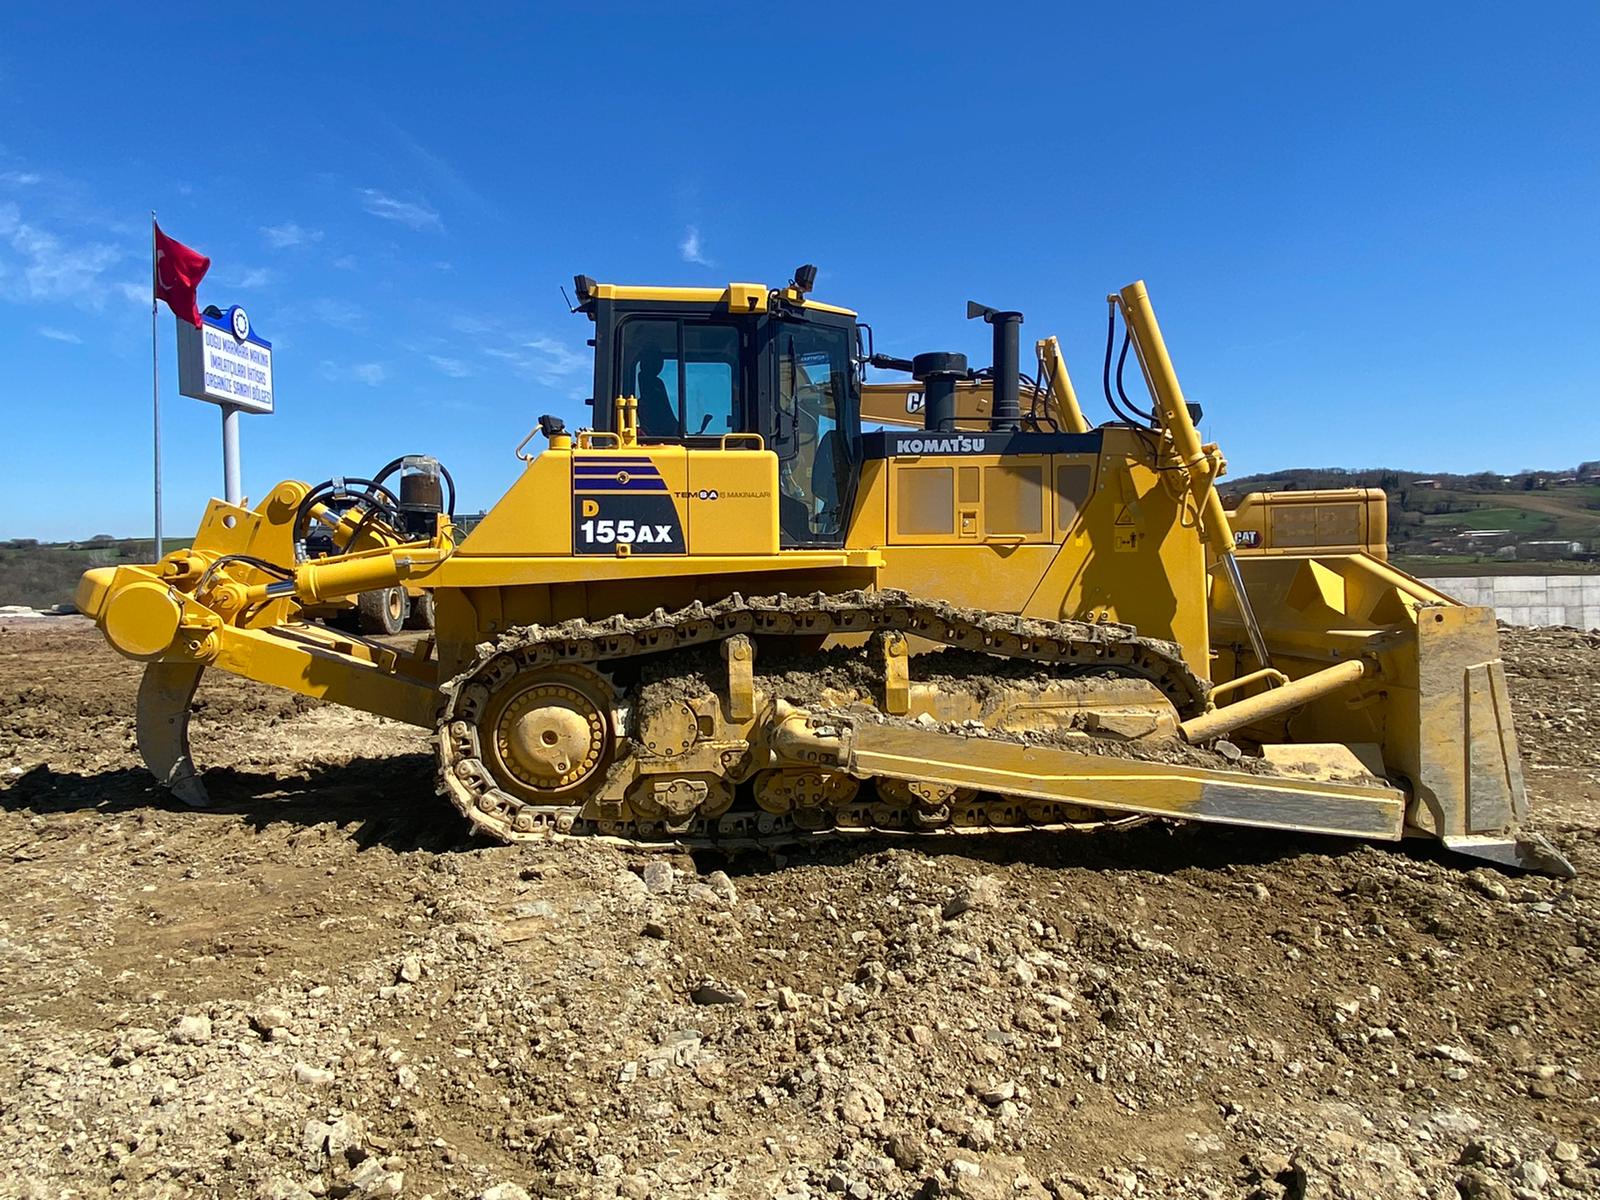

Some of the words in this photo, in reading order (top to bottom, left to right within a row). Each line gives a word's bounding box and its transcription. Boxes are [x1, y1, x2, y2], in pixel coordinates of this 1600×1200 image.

[897, 436, 984, 453] KOMATSU
[674, 490, 718, 500] TEMSA
[582, 500, 599, 517] D
[581, 520, 672, 543] 155AX
[1234, 531, 1256, 544] CAT
